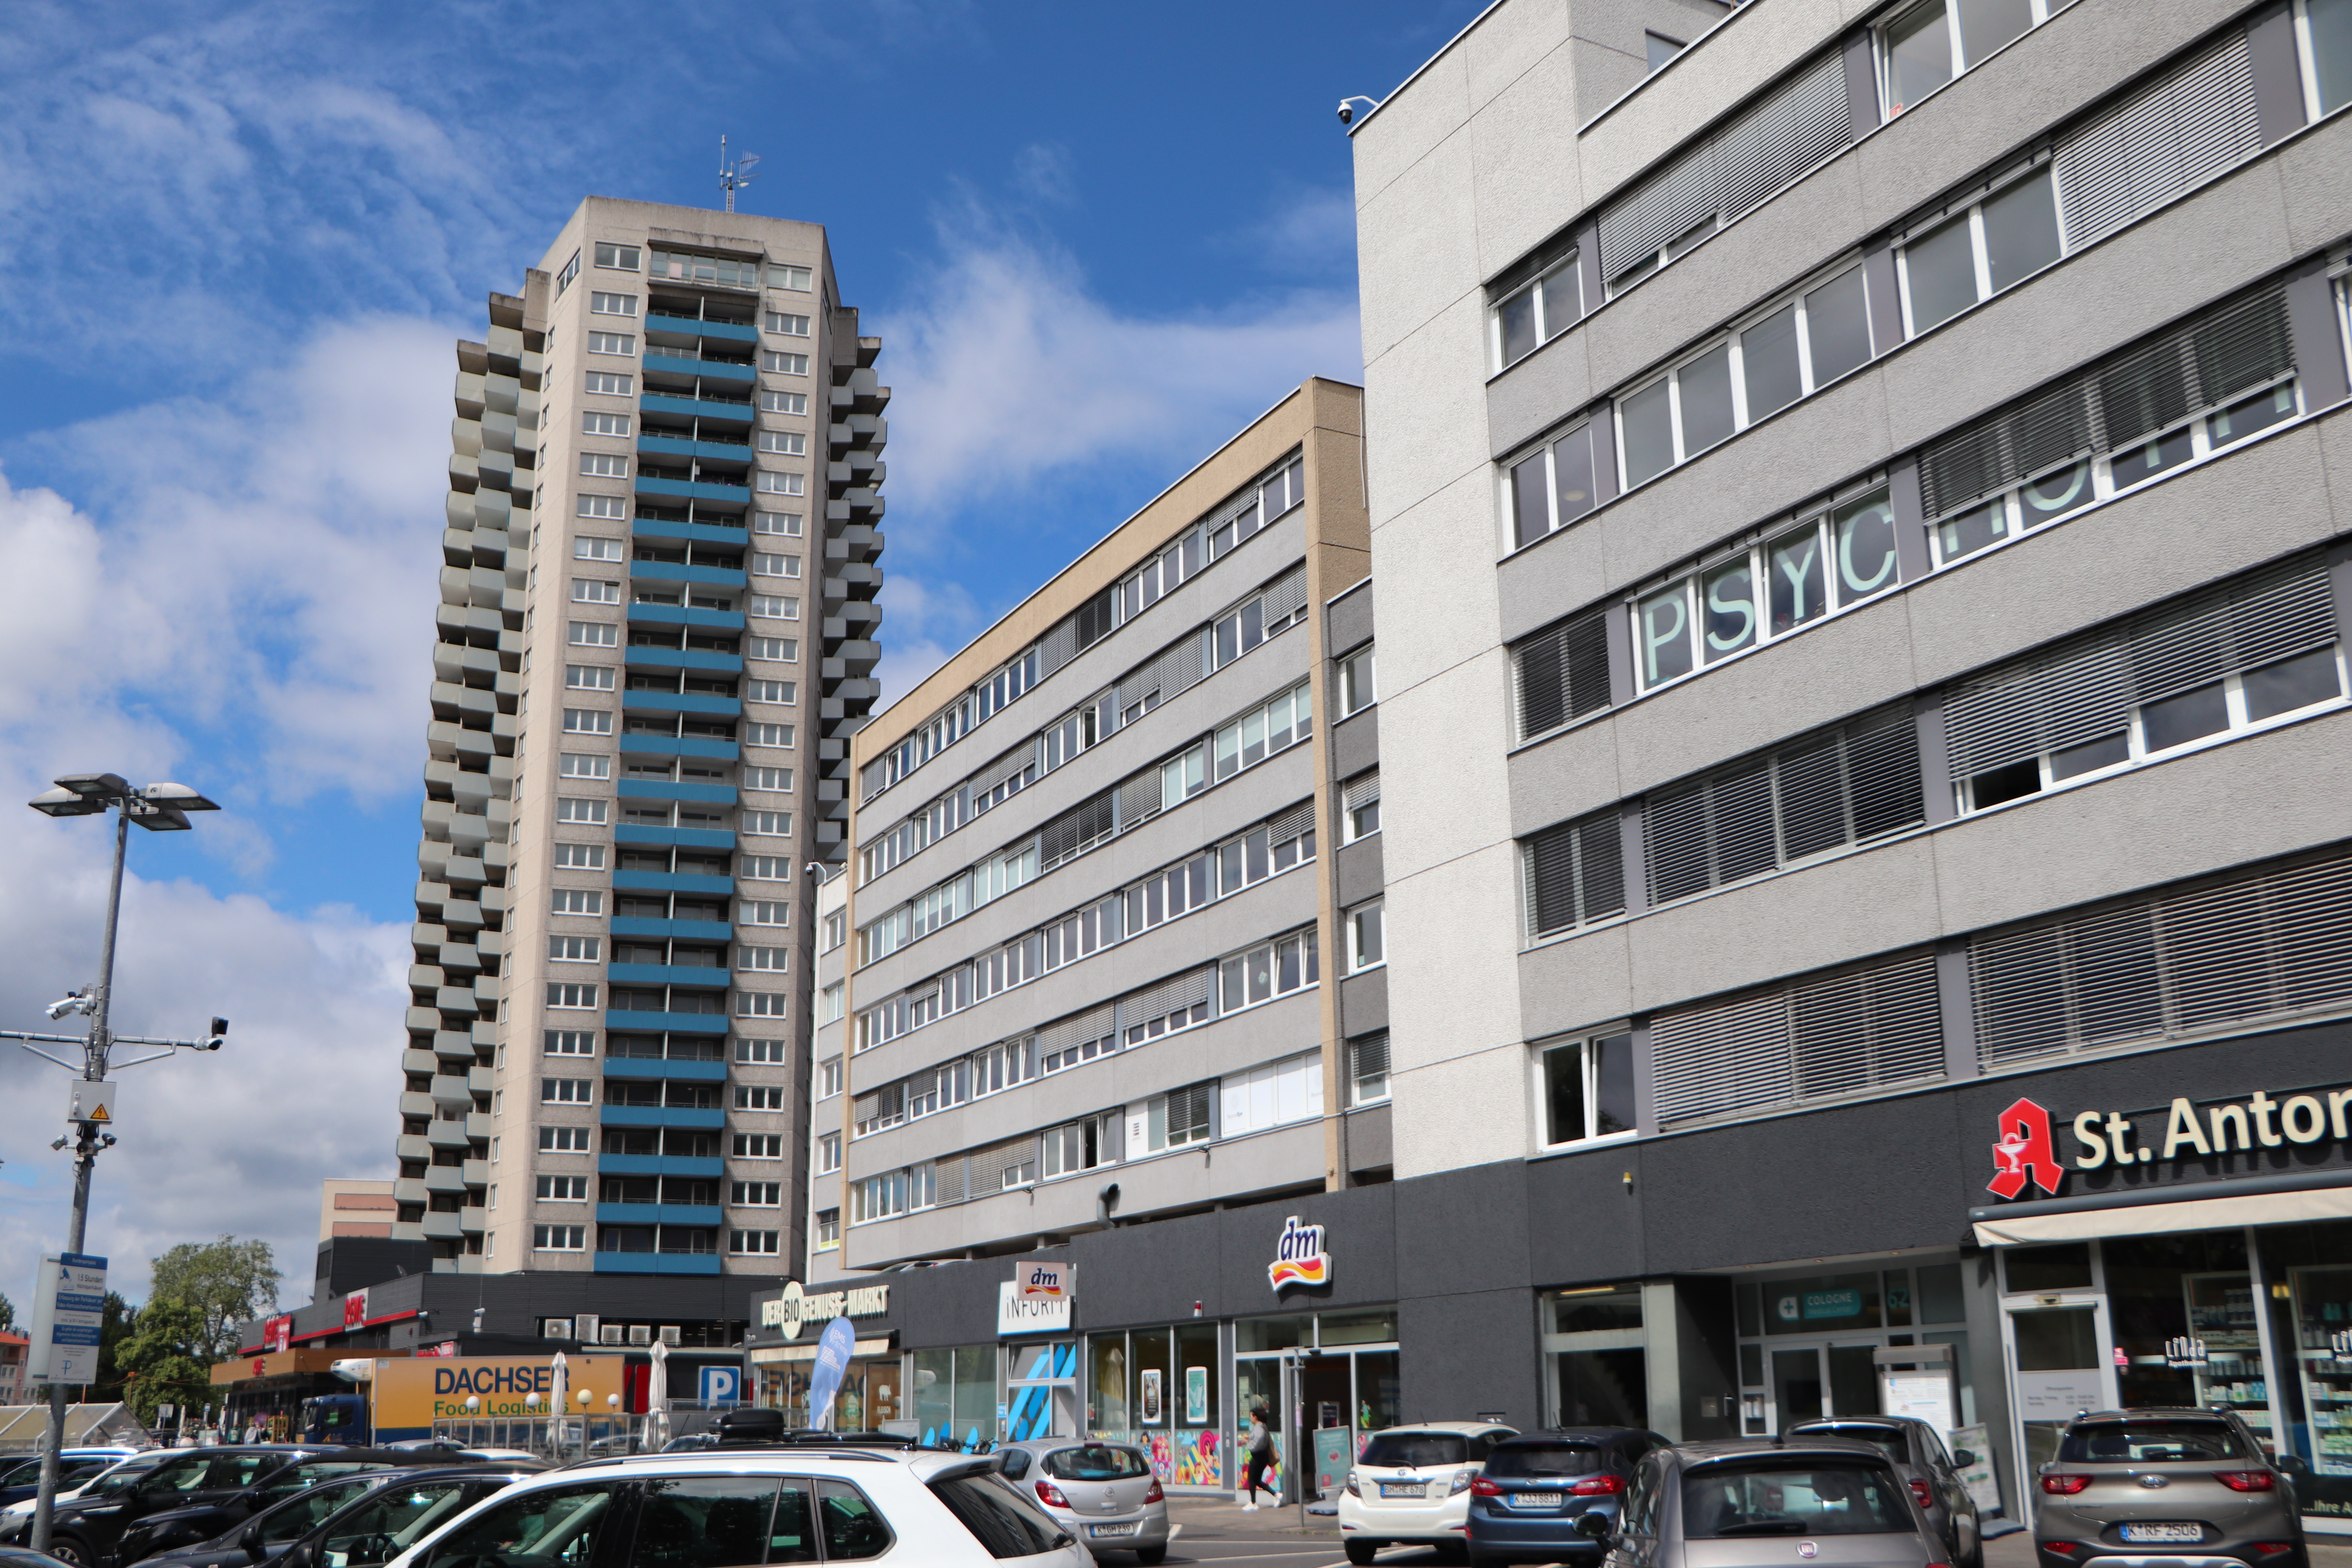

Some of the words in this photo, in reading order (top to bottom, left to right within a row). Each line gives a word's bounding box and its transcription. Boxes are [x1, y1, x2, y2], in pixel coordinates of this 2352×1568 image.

[2073, 1111, 2152, 1169] St.
[1281, 1220, 1318, 1261] dm
[1031, 1268, 1057, 1285] dm
[1807, 1293, 1853, 1305] COLOGNE
[762, 1299, 782, 1325] DER
[784, 1298, 799, 1323] BIO
[834, 1329, 846, 1344] EMS
[708, 1370, 733, 1406] P
[1385, 1484, 1394, 1494] BN
[1399, 1484, 1409, 1494] HE
[1410, 1484, 1425, 1494] 678
[1514, 1494, 1521, 1503] K
[1098, 1525, 1103, 1534] K
[1117, 1524, 1130, 1533] 239
[2128, 1524, 2137, 1536] K
[2145, 1523, 2161, 1536] RF
[2166, 1523, 2198, 1536] 2506
